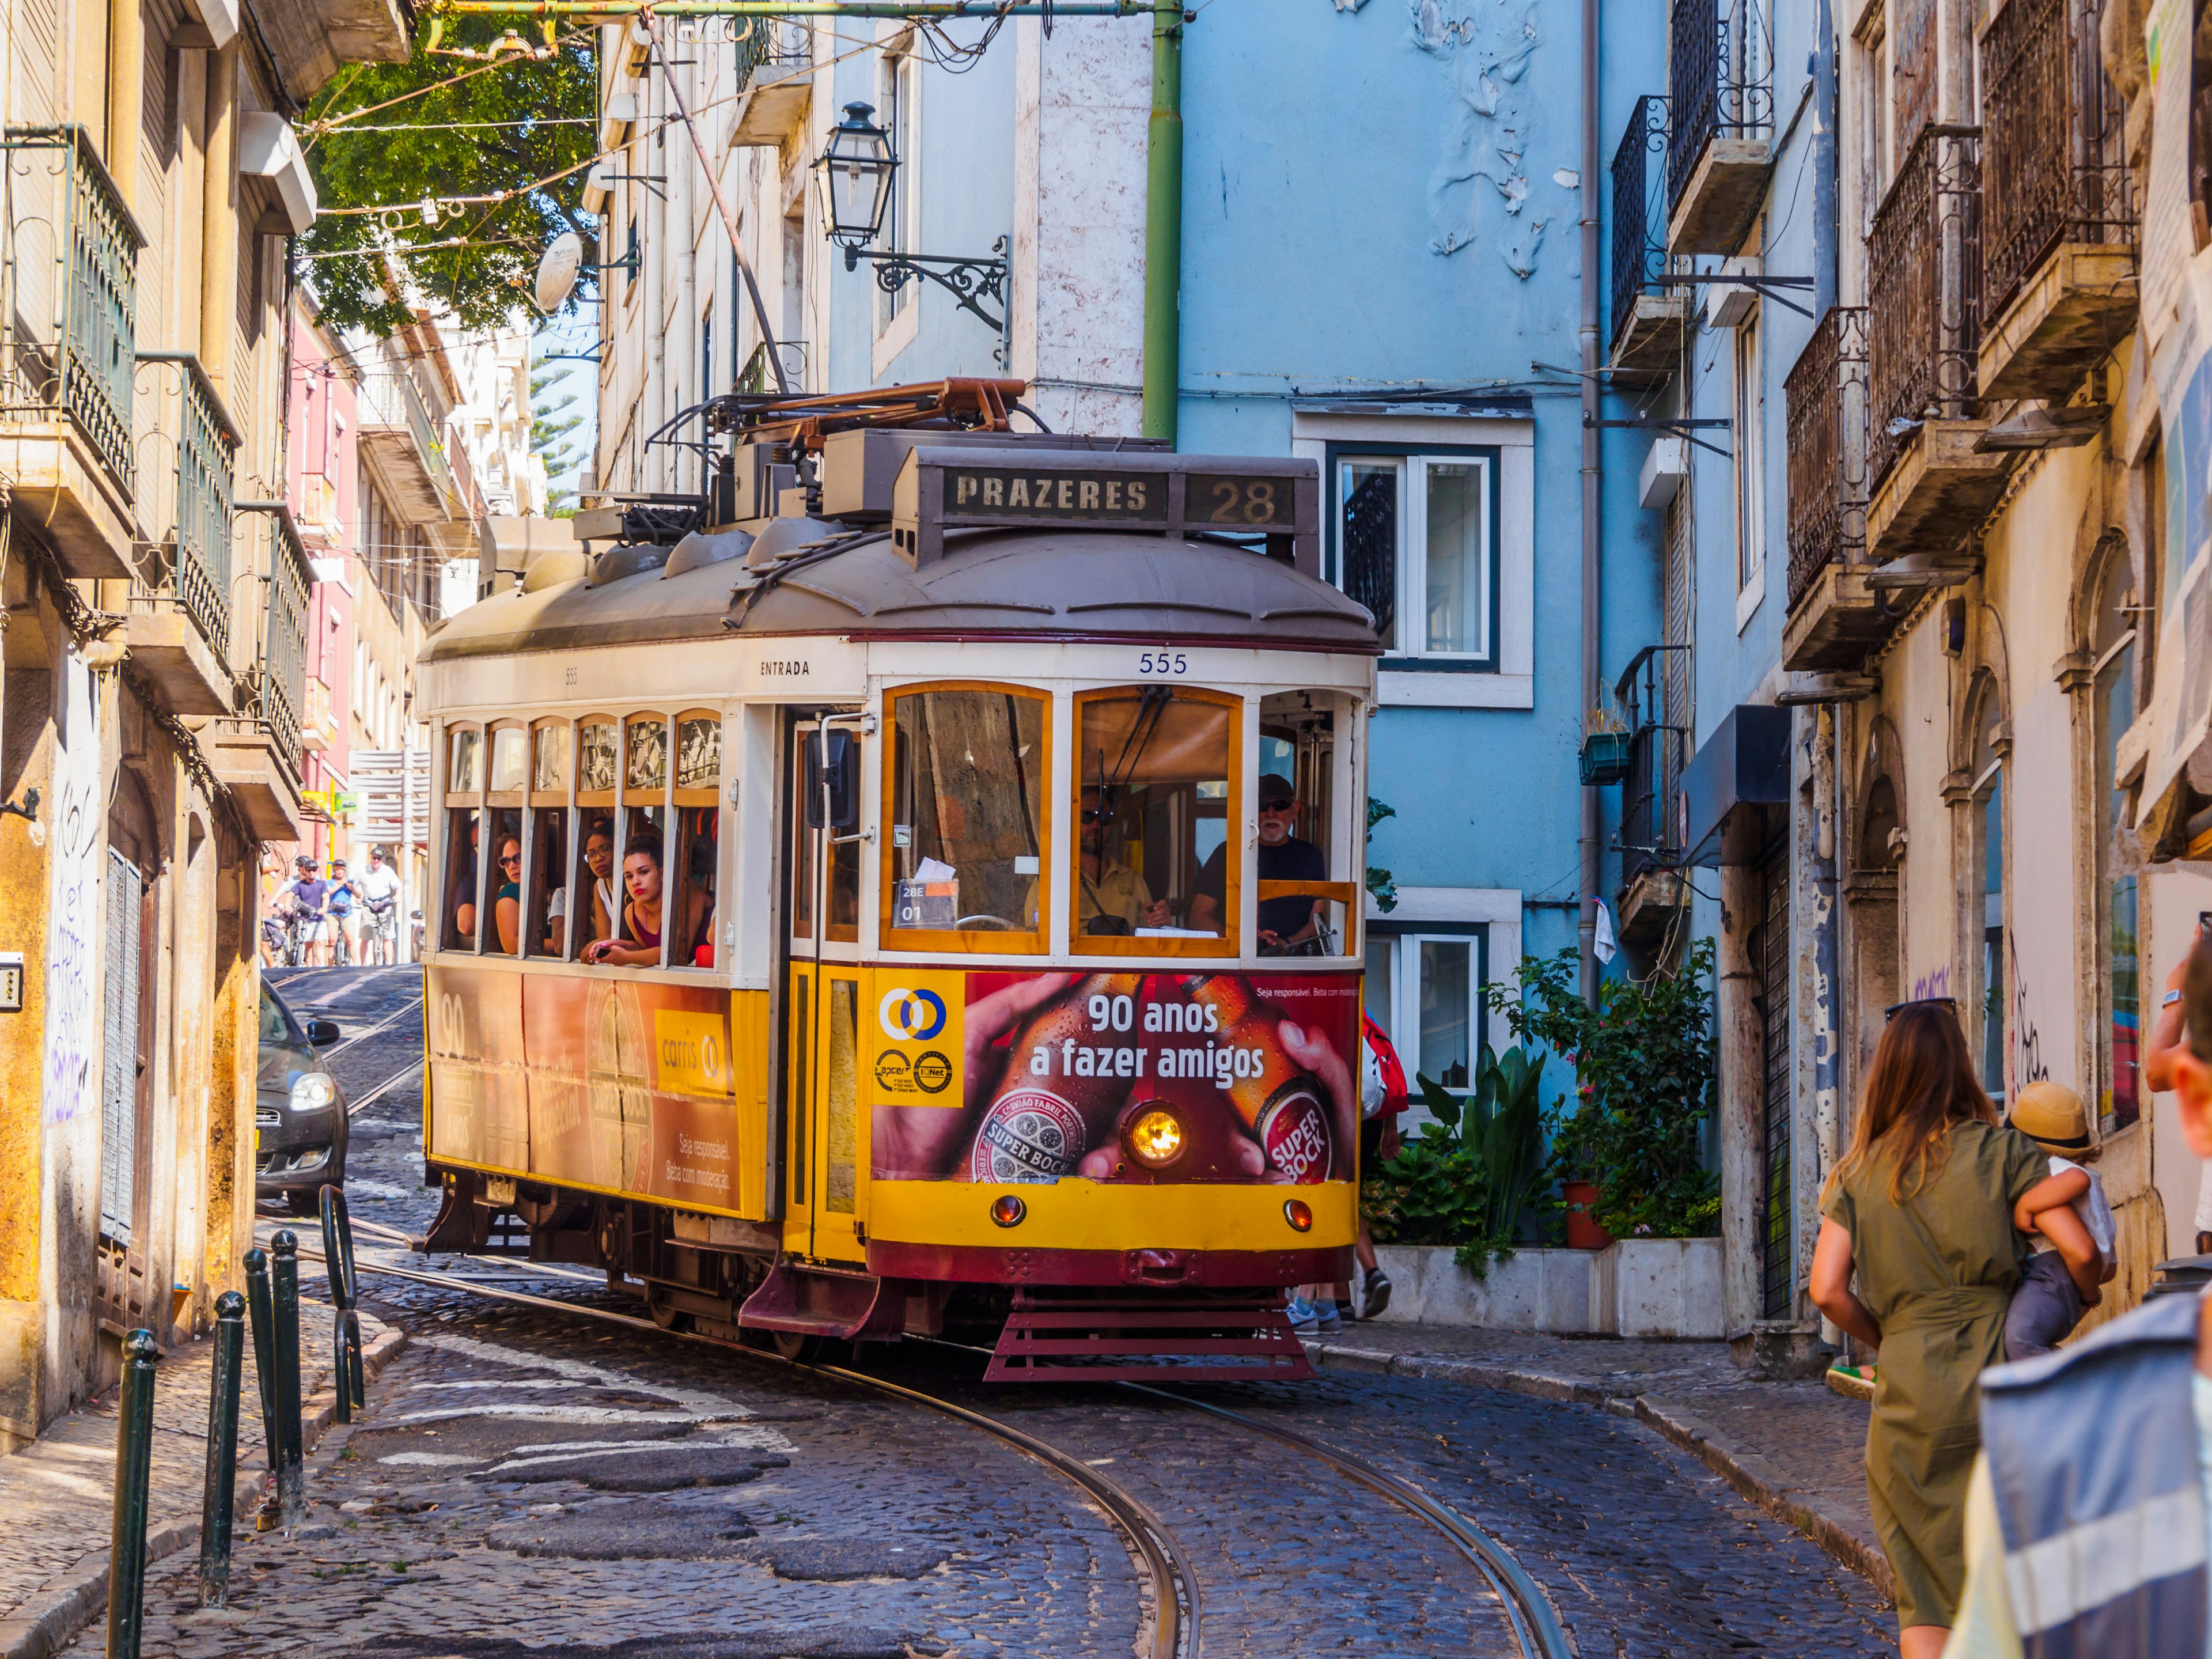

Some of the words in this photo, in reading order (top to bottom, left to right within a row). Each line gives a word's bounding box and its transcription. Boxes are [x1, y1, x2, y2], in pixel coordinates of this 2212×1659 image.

[957, 476, 1146, 511] PRAZERES
[1211, 480, 1275, 525] 28
[566, 666, 578, 685] 555
[760, 661, 810, 676] ENTRADA
[1139, 653, 1187, 674] 555
[903, 887, 924, 897] 28E
[902, 906, 922, 921] 01
[1256, 987, 1272, 998] Seja
[1313, 987, 1327, 997] Beba
[442, 993, 465, 1059] 90
[1088, 994, 1133, 1032] 90
[1143, 1002, 1219, 1033] anos
[662, 1028, 697, 1070] carris
[1030, 1046, 1050, 1076] a
[1062, 1038, 1148, 1078] fazer
[1157, 1040, 1264, 1090] amigos
[881, 1067, 905, 1077] apcer
[921, 1068, 945, 1077] IQNet
[1035, 1099, 1062, 1116] FABRIL
[679, 1132, 692, 1159] Seja
[694, 1138, 730, 1161] responsável.
[987, 1123, 1031, 1160] SUPER
[1271, 1108, 1320, 1168] SUPER
[1282, 1127, 1325, 1183] BOCK
[666, 1160, 681, 1181] Beba
[683, 1167, 695, 1184] com
[696, 1166, 730, 1194] moderação.
